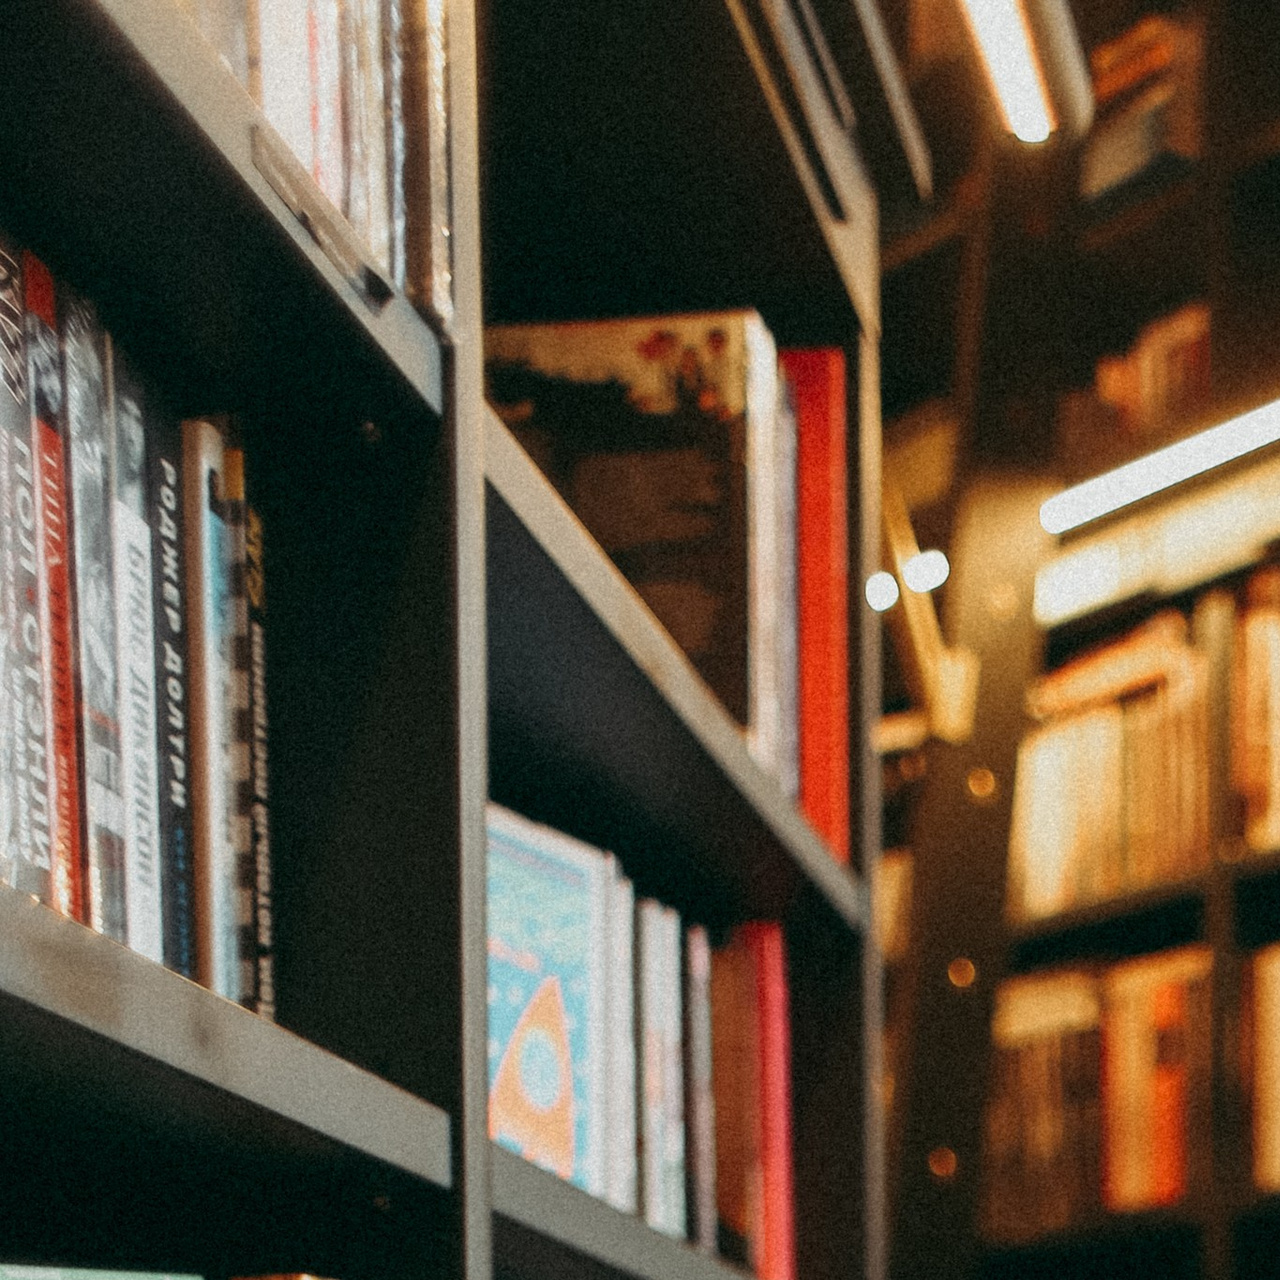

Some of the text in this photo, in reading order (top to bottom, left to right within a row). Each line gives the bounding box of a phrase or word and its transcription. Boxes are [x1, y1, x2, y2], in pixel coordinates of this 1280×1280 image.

[14, 437, 50, 872] ПОЛ СТЭНЛИ
[158, 459, 181, 632] РОДЖЕР
[127, 542, 154, 888] БРЮС ДИКИНСОН
[163, 642, 187, 808] ДОЛТРИ
